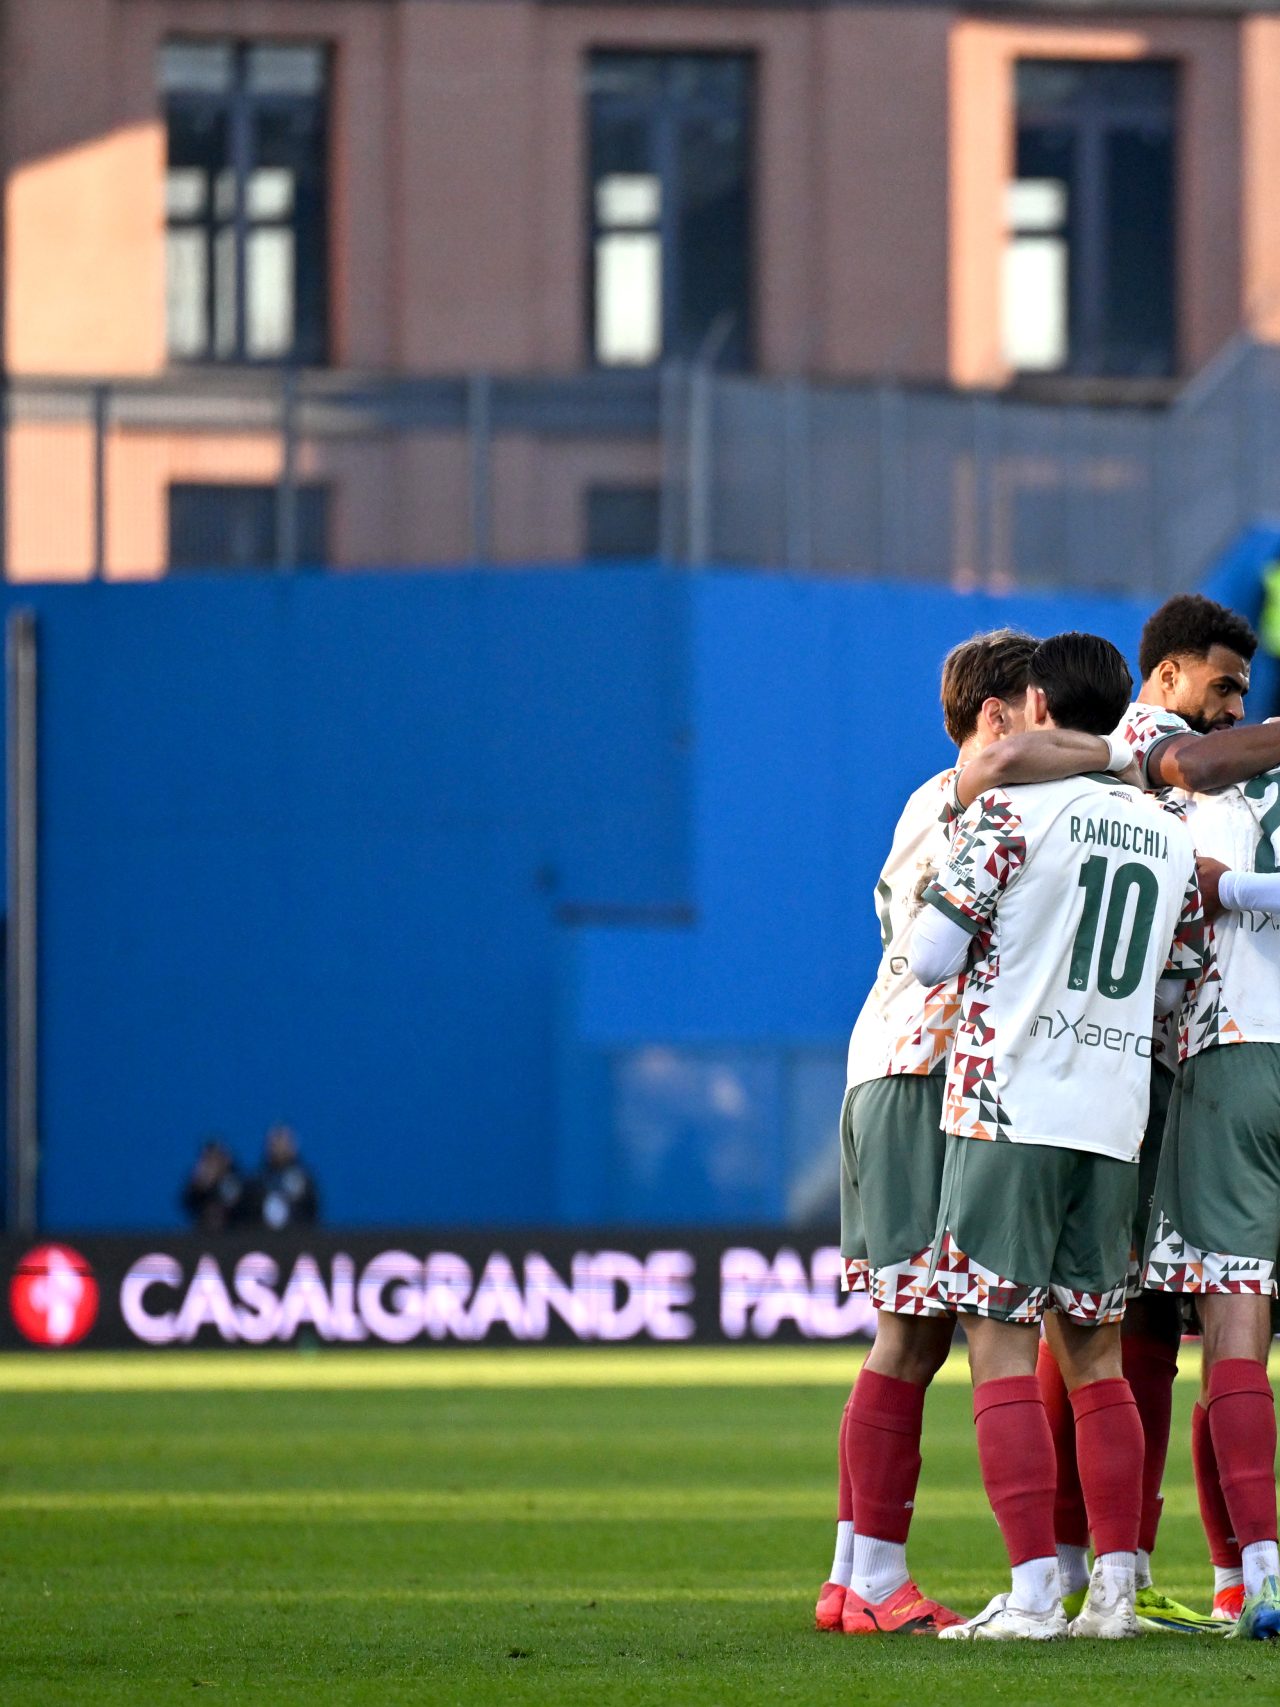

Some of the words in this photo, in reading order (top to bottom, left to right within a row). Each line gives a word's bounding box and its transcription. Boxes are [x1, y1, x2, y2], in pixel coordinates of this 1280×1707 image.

[1070, 815, 1169, 863] RANOCCHIA
[1067, 855, 1159, 999] 10
[1030, 1009, 1152, 1058] inX.aero
[119, 1250, 697, 1344] CASALGRANDE
[720, 1246, 880, 1340] PAD
